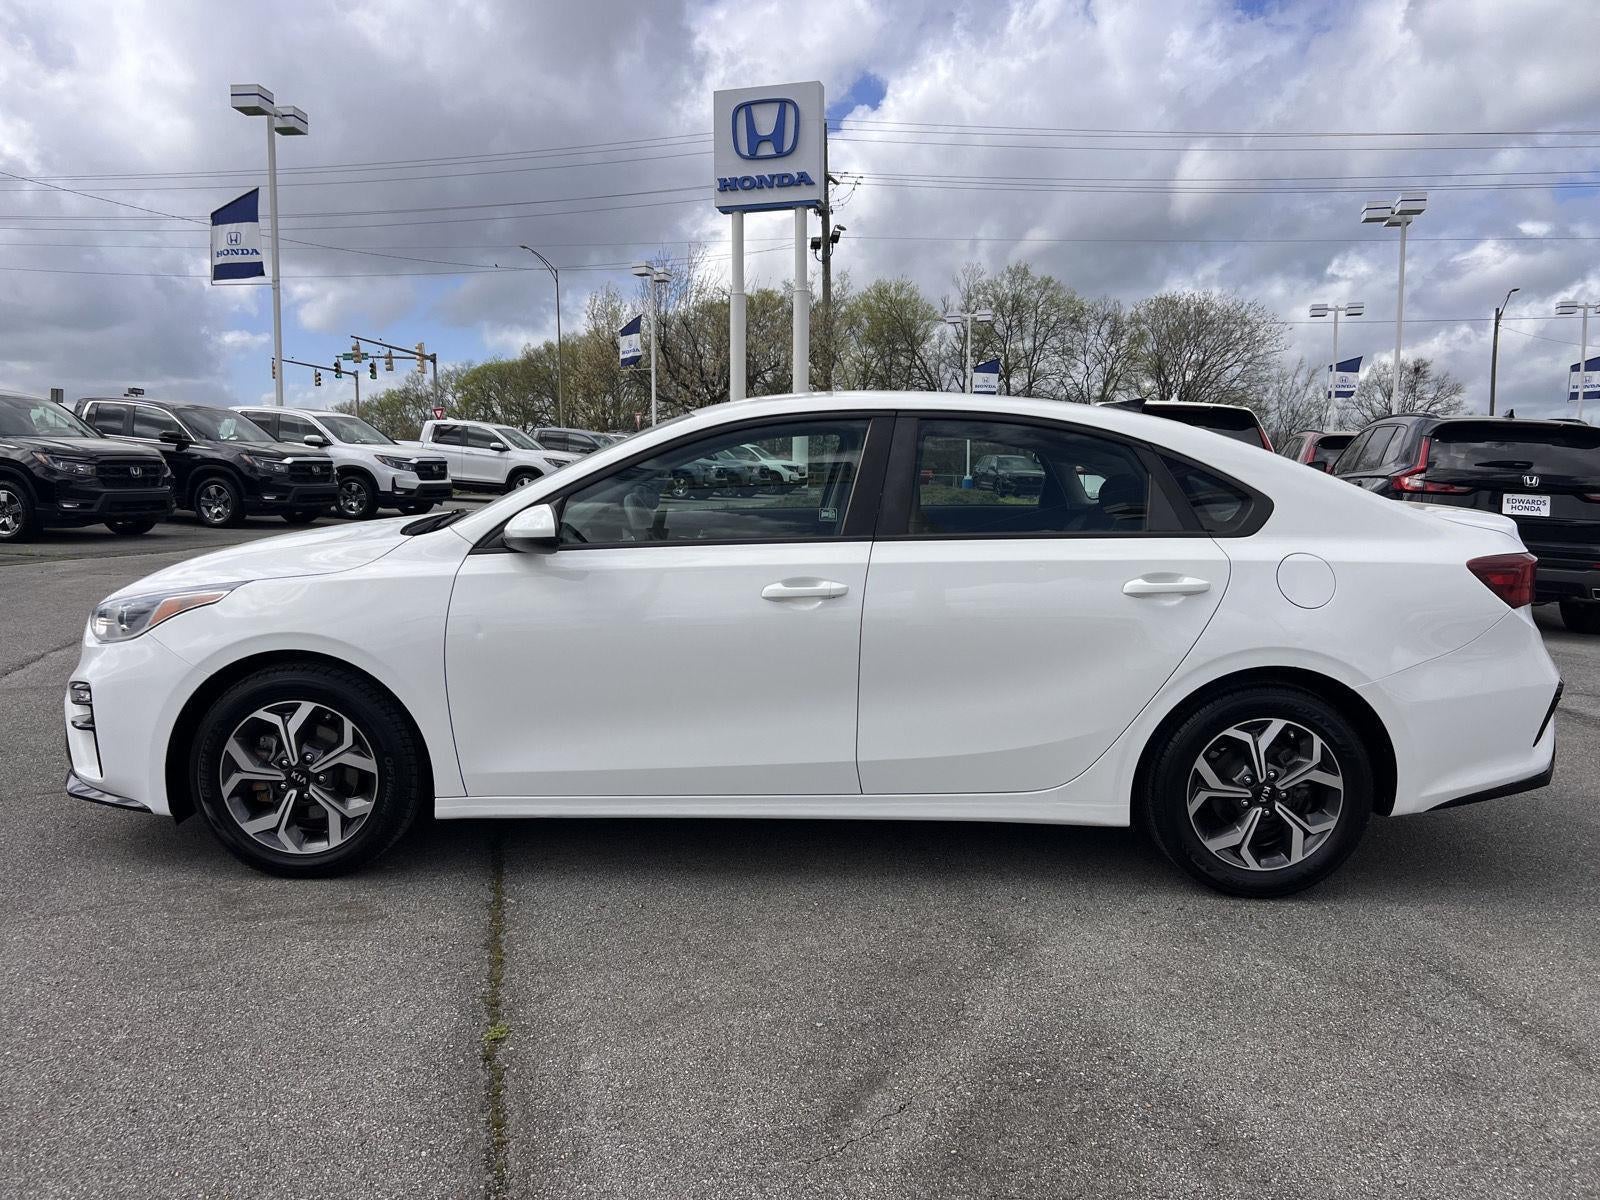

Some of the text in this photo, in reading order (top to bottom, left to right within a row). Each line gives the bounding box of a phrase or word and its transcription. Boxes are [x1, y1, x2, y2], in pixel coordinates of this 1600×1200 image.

[717, 170, 816, 193] HONDA
[216, 248, 261, 258] HONDA
[1506, 497, 1547, 506] EDWARDS
[1510, 504, 1542, 512] HONDA
[290, 770, 307, 785] KIA
[1258, 785, 1272, 802] KIA
